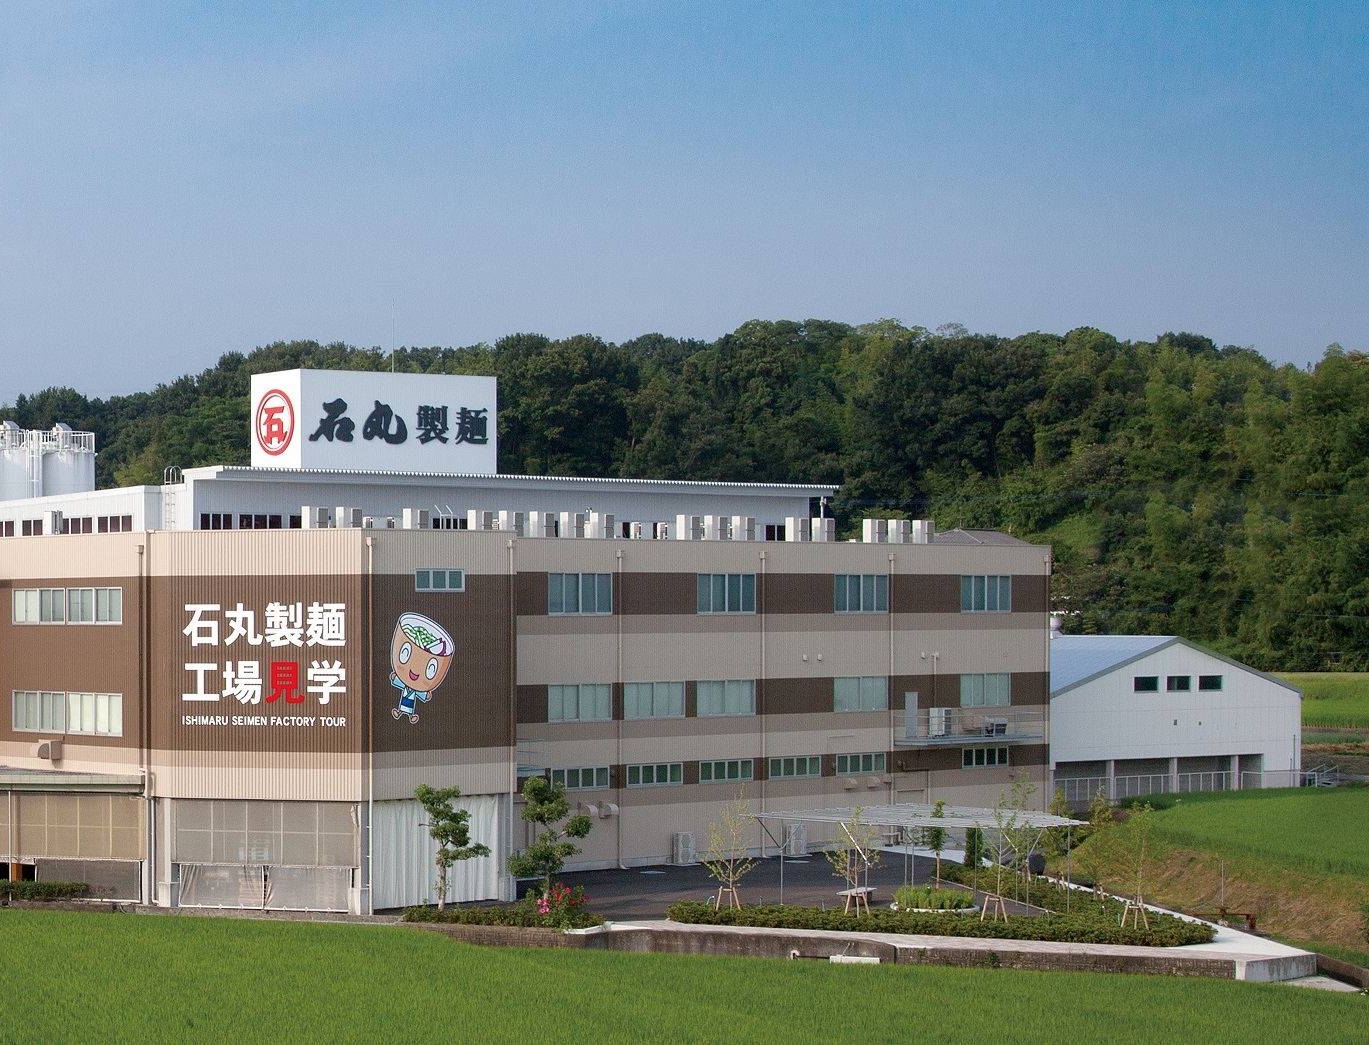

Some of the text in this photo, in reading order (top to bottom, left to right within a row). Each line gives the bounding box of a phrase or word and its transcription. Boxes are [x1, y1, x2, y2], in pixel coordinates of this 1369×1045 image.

[308, 397, 489, 445] 石丸製麺
[182, 601, 347, 648] 石丸製麺
[182, 660, 346, 705] 工場見学
[181, 715, 346, 727] ISHIMARU SEIMEN FACTORY TOUR
